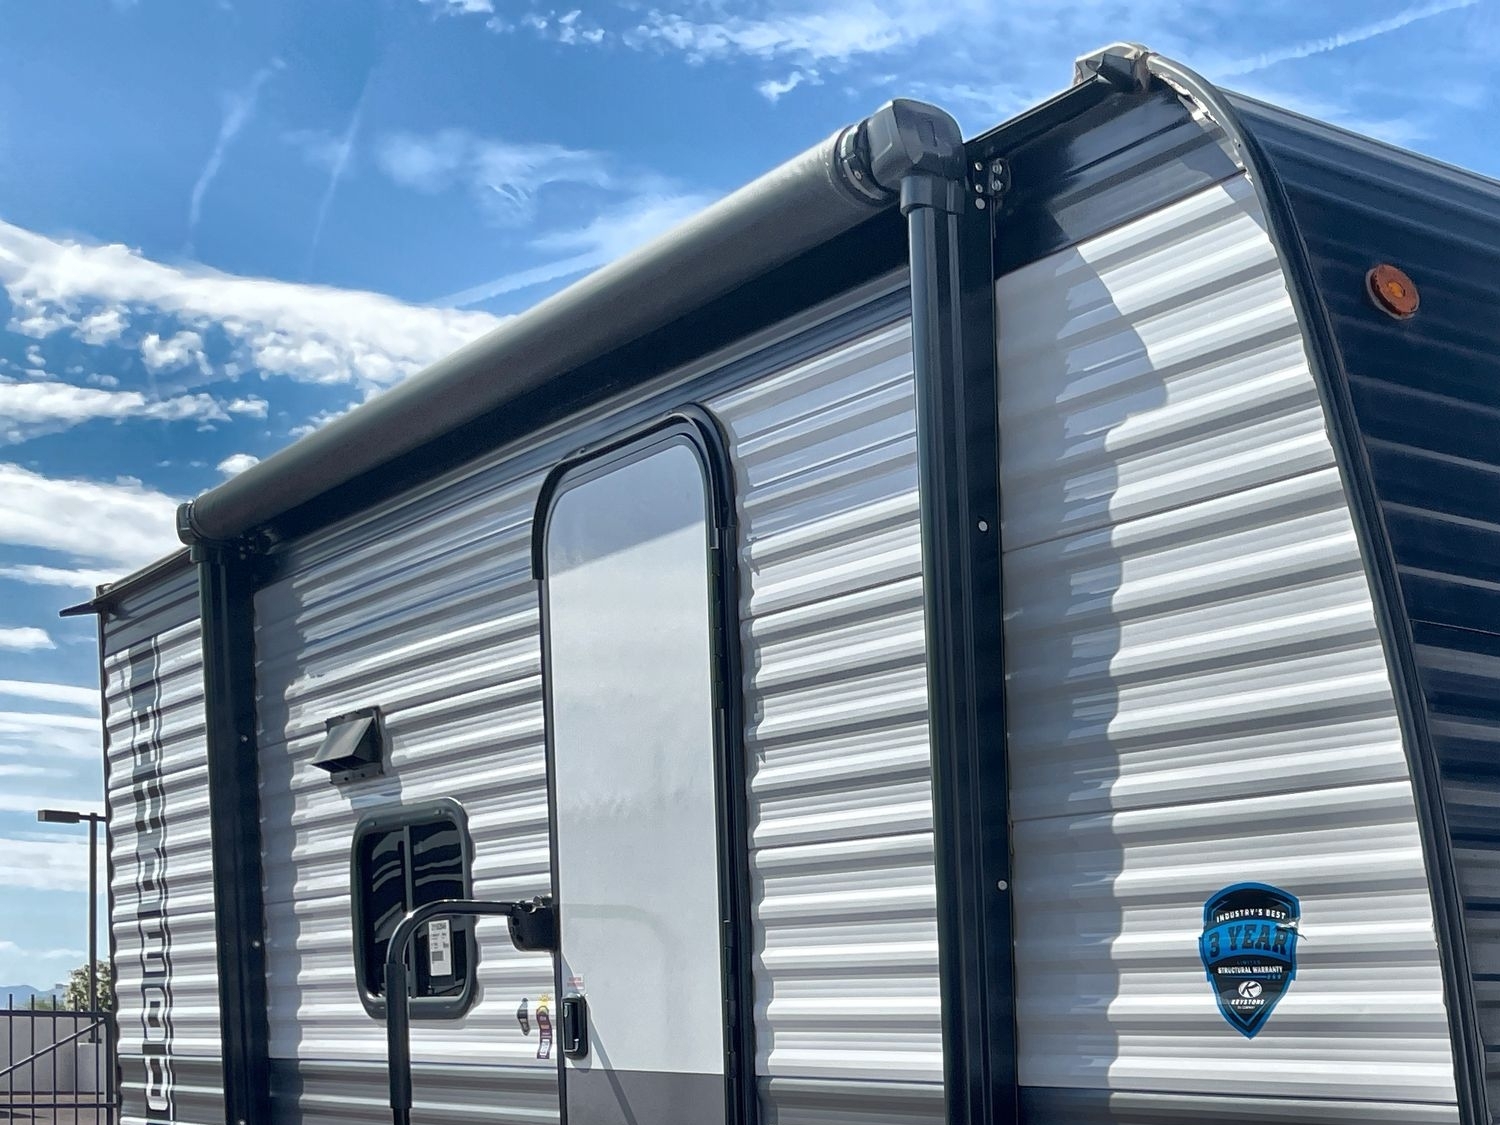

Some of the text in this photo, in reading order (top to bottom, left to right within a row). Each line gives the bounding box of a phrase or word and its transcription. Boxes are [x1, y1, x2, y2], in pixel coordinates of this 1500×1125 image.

[1216, 908, 1287, 923] INDUSTRY'S BEST
[1208, 924, 1288, 958] 3 YEAR
[1217, 965, 1284, 975] STRUCTURAL WARRANTY
[1230, 998, 1265, 1006] KEYSTONE
